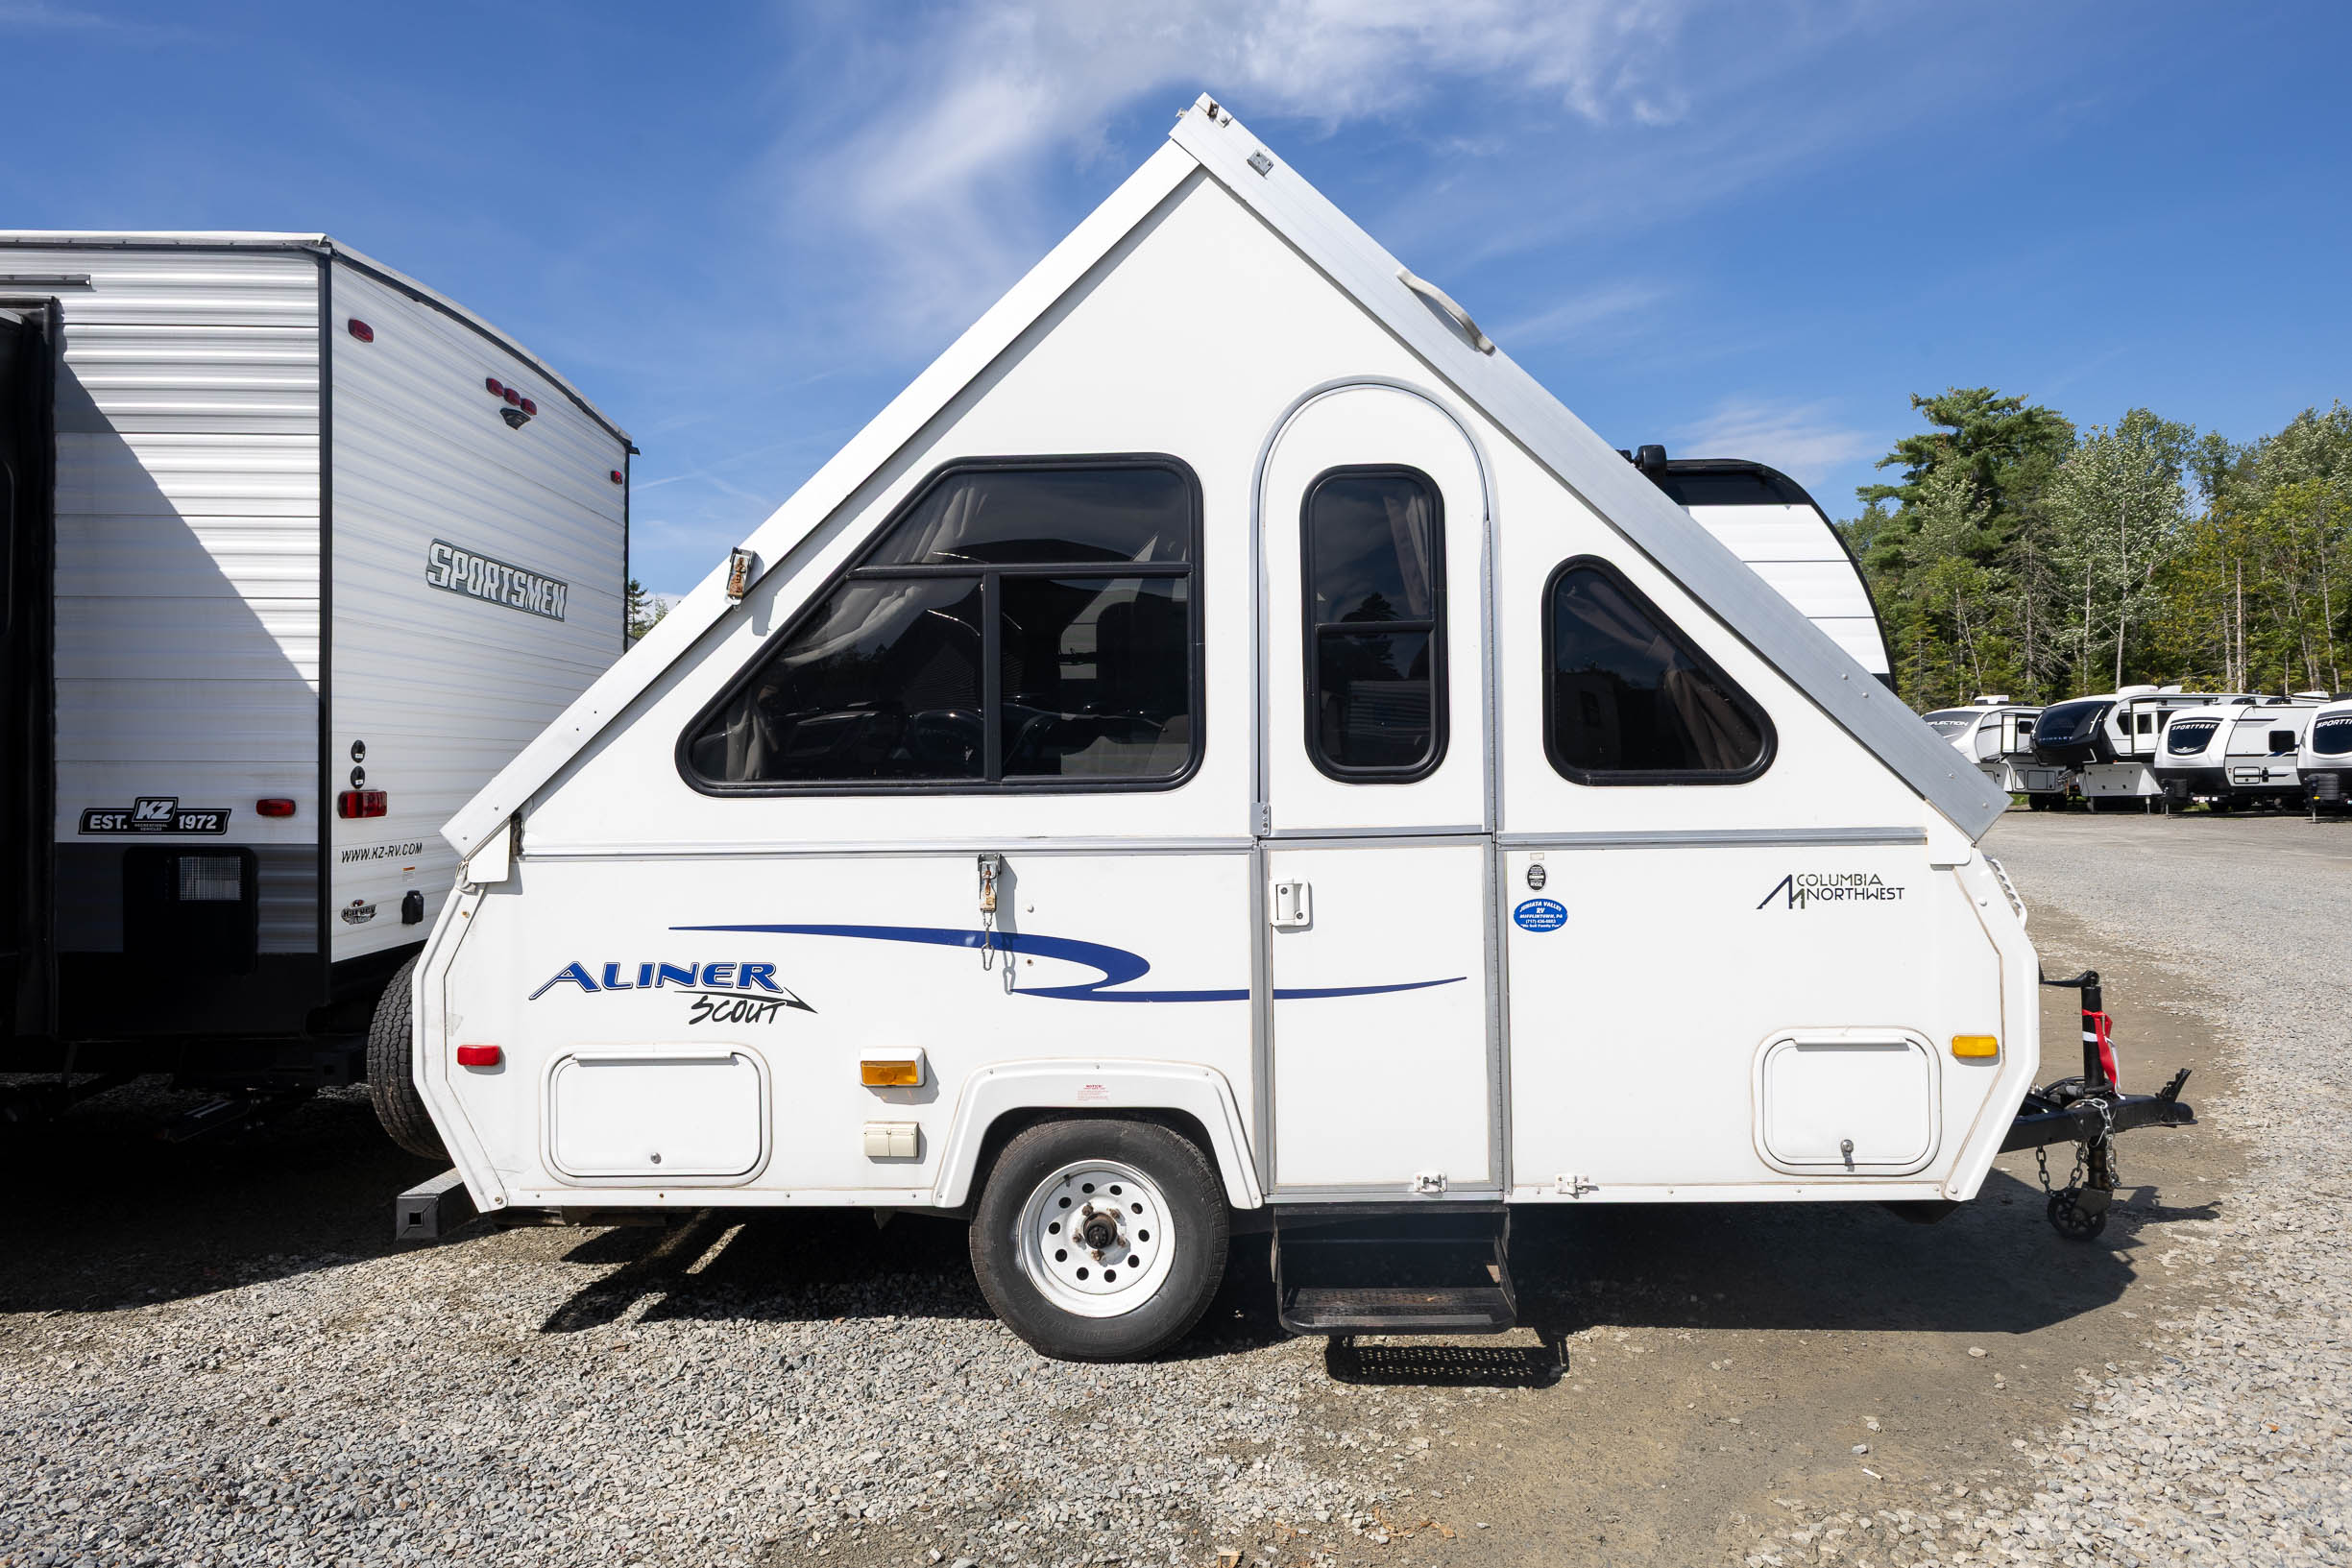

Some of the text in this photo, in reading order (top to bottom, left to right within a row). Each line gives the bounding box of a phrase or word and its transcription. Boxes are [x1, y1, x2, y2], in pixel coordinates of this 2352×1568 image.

[426, 542, 567, 618] SPORTSMEN
[135, 801, 175, 820] KZ
[89, 814, 217, 830] EST. 1972
[341, 842, 423, 863] WWW.KZ-RV.COM
[1796, 873, 1883, 886] COLUMBIA
[1806, 887, 1904, 901] NORTHWEST
[528, 960, 784, 1000] ALINER
[689, 995, 787, 1025] SCOUT
